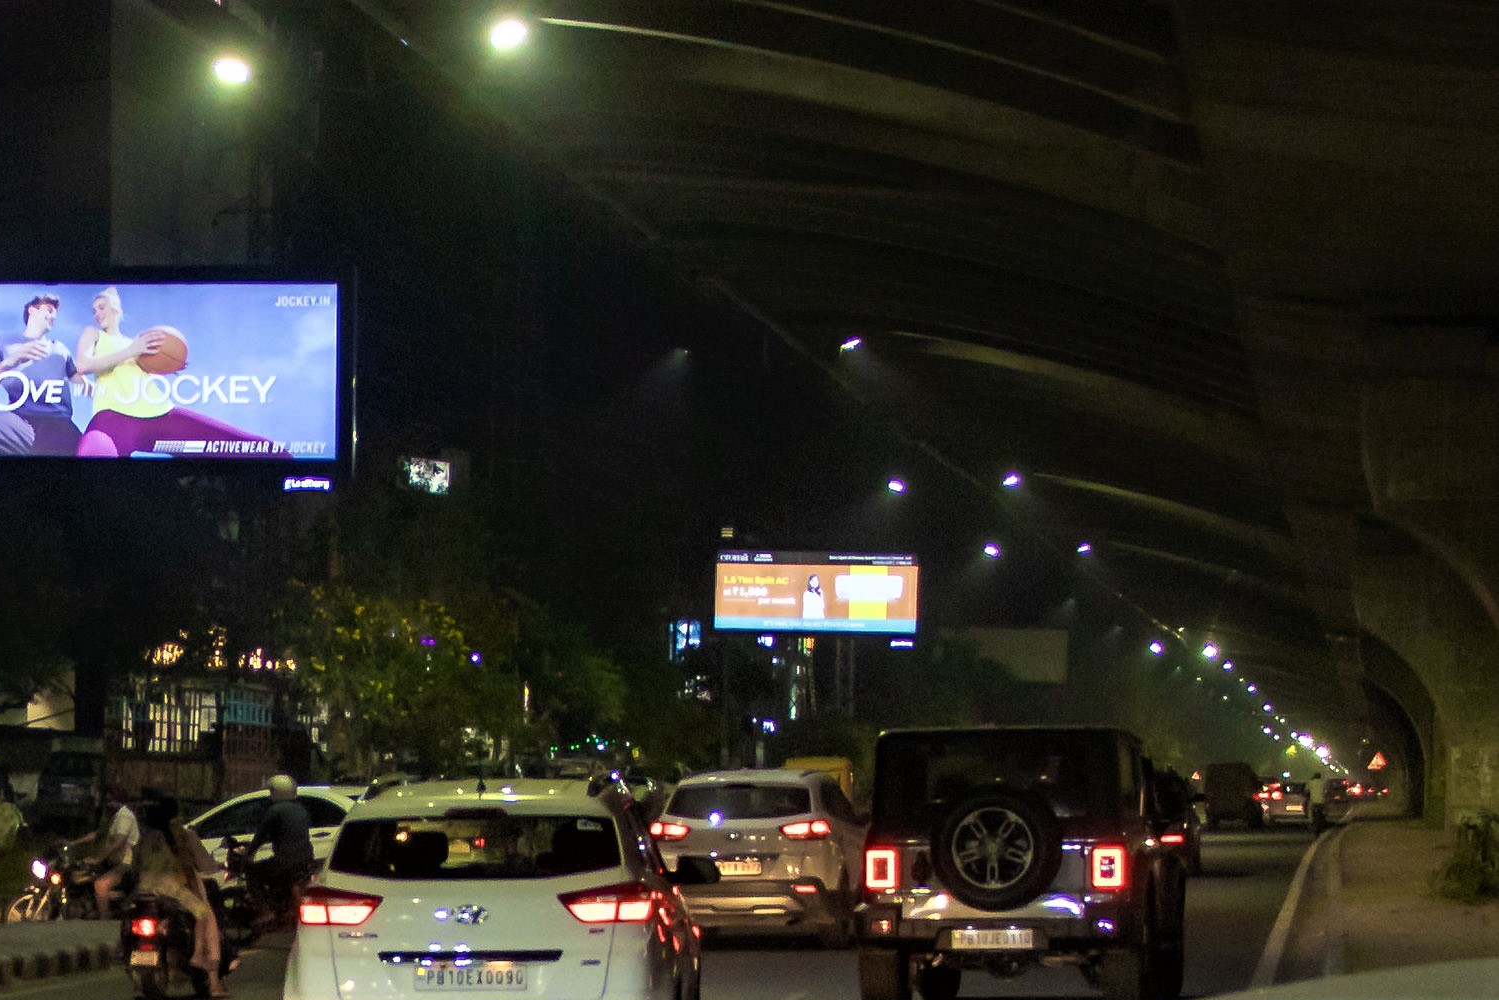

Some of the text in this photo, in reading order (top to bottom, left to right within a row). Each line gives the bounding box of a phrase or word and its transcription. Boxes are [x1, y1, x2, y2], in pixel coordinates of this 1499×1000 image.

[275, 295, 330, 307] JOCKEY.IN
[115, 373, 277, 405] JOCKEY
[205, 440, 326, 453] ACTIVEWEAR BY JOCKEY
[776, 576, 789, 585] AC
[426, 967, 524, 986] PB10EX0090
